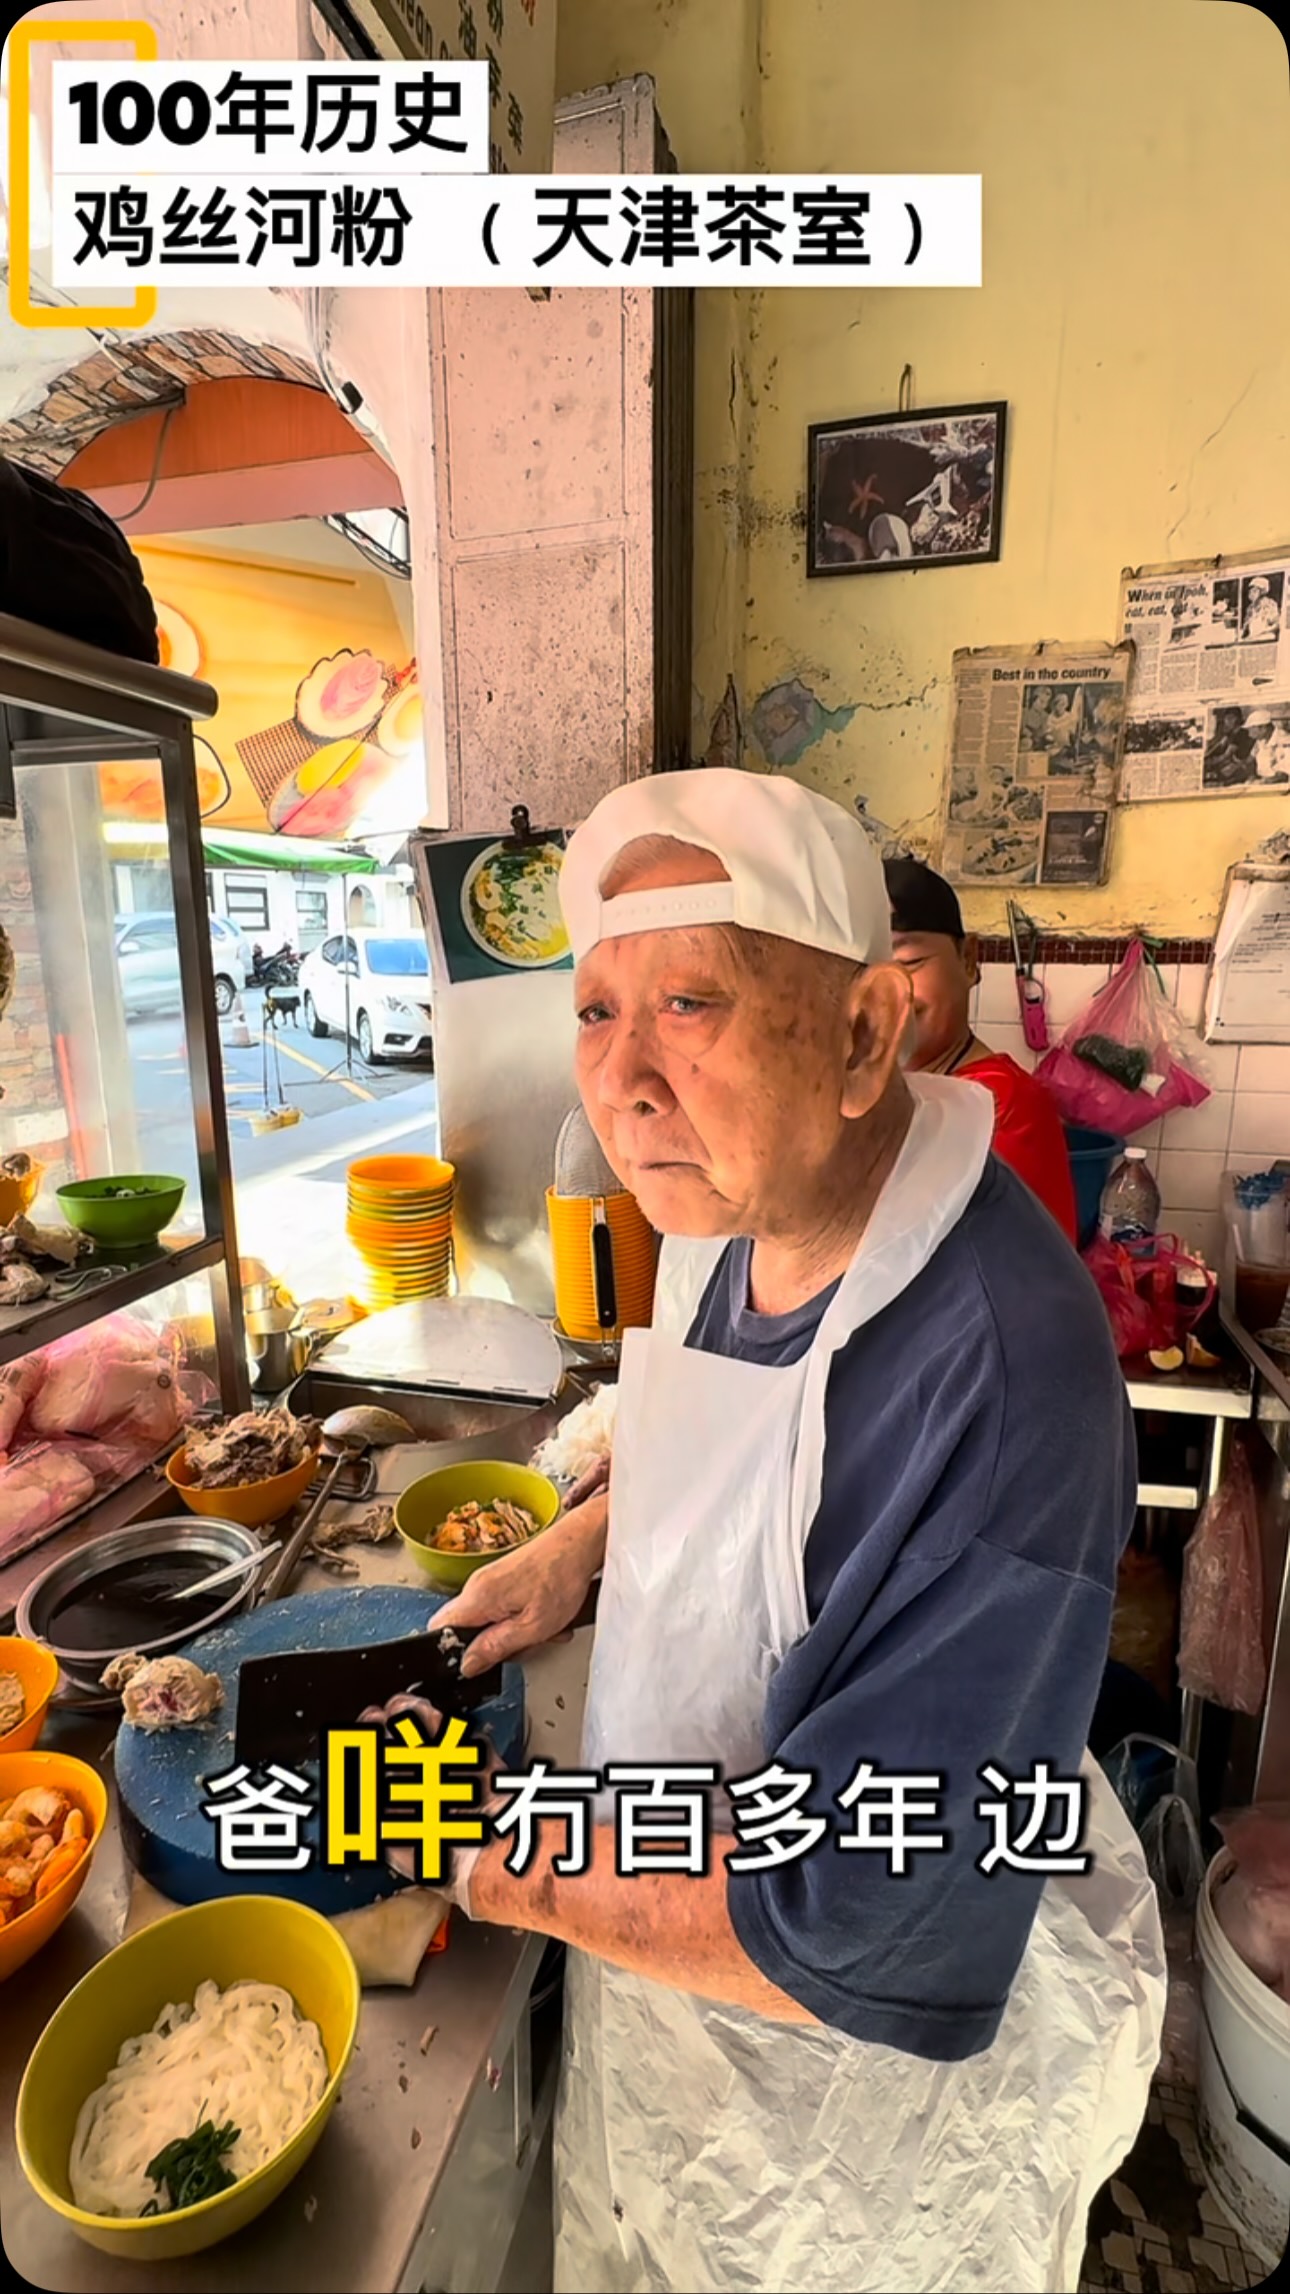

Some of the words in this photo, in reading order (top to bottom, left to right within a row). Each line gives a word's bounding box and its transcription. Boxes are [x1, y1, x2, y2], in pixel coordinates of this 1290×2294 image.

[992, 669, 1020, 681] Best
[1023, 667, 1035, 680] in
[1038, 668, 1058, 680] the
[1061, 667, 1111, 679] country
